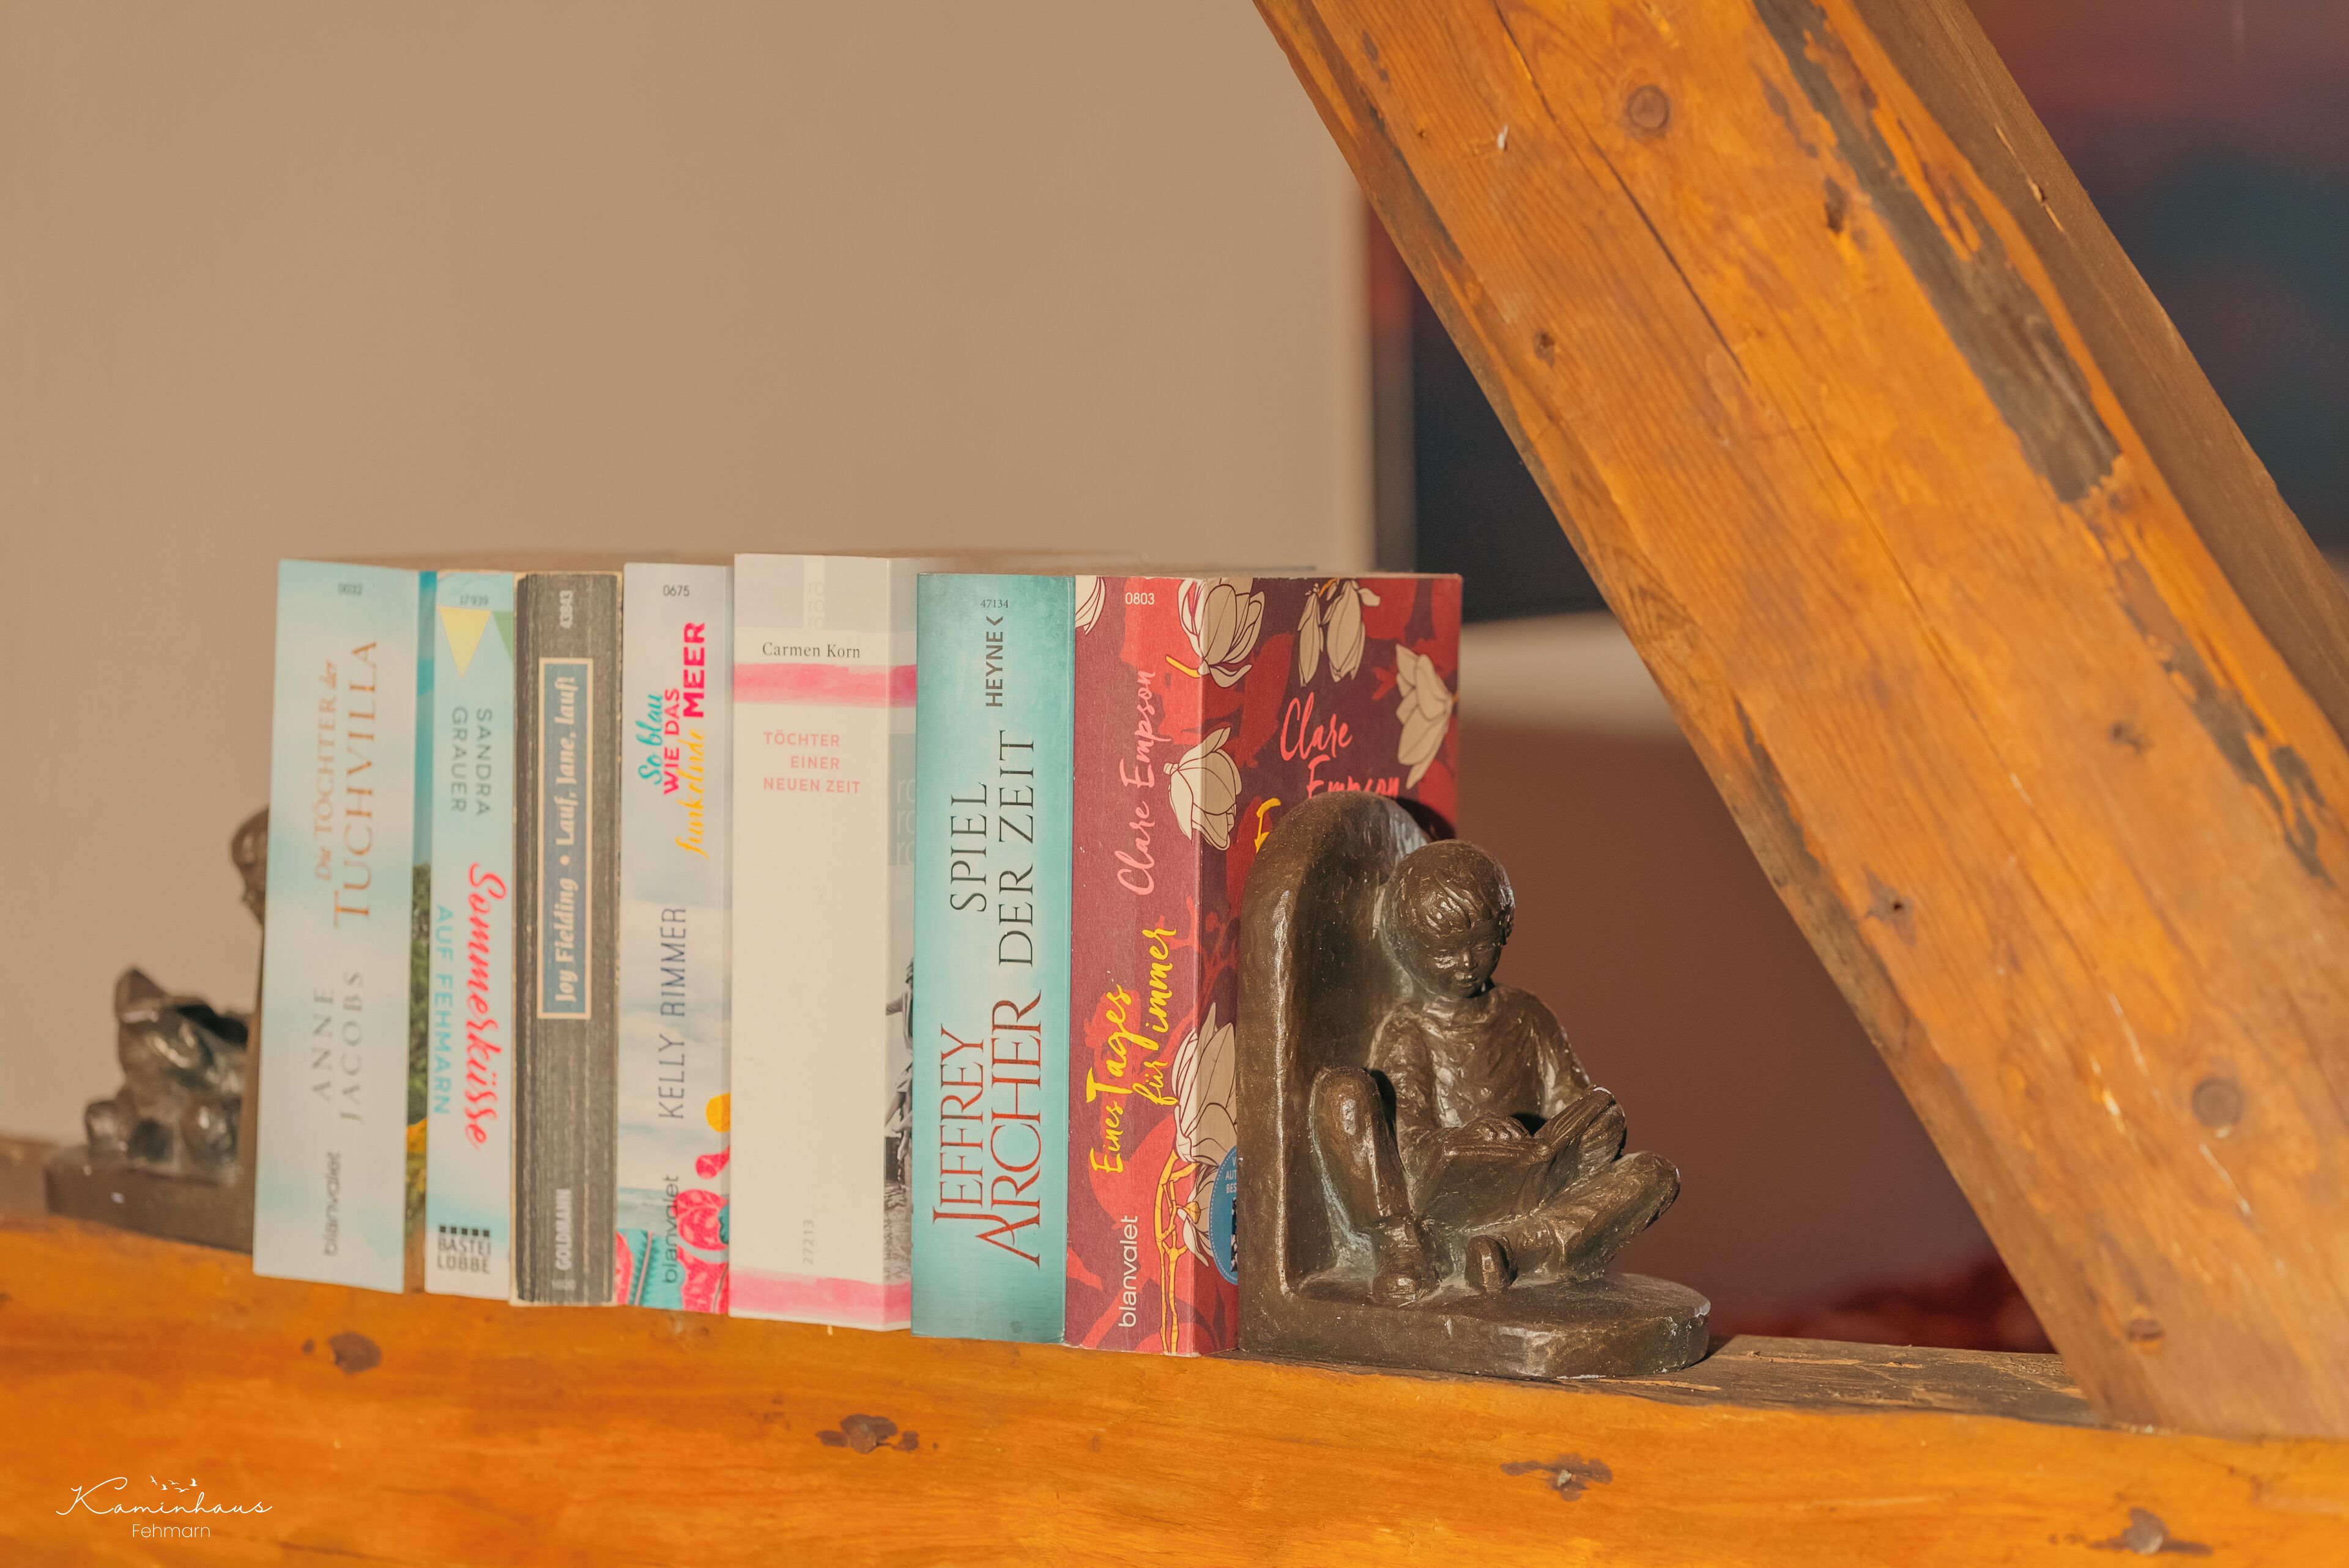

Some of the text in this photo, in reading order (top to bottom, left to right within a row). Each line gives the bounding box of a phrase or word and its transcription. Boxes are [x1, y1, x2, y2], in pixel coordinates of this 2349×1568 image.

[559, 589, 574, 630] 43843
[663, 585, 690, 597] 0675
[980, 599, 1009, 608] 47134
[1125, 592, 1155, 605] 0803
[683, 622, 706, 719] MEER
[762, 642, 861, 659] Carmen Korn
[985, 631, 1003, 707] HEYNE
[311, 658, 338, 882] Die TÖCHTER der
[451, 706, 468, 813] GRAUER
[475, 708, 492, 816] SANDRA
[636, 693, 664, 786] So blau
[663, 688, 680, 795] WIE DAS
[763, 730, 840, 747] TÖCHTER
[790, 756, 840, 769] EINER
[1280, 691, 1353, 761] Clare
[334, 642, 377, 928] TUCHVILLA
[675, 728, 710, 860] funkelnde
[763, 778, 861, 794] NEUEN ZEIT
[1115, 670, 1171, 895] Clare Empson
[553, 676, 579, 1002] Joy Fielding Lauf, Jane, lauf!
[950, 783, 987, 912] SPIEL
[998, 730, 1034, 968] DER ZEIT
[311, 988, 334, 1101] ANNE
[339, 971, 363, 1124] JACOBS
[432, 903, 453, 1115] AUF FEHMARN
[464, 862, 507, 1151] Sommerküsse
[658, 906, 686, 1120] KELLY RIMMER
[1133, 926, 1179, 1106] für immer
[975, 989, 1041, 1270] ARCHER
[1086, 983, 1159, 1174] Eines Tages
[933, 1023, 1015, 1246] JEFFREY
[323, 1151, 342, 1257] blanvalet
[438, 1237, 491, 1255] BASTEI
[555, 1188, 573, 1271] GOLDMANN
[662, 1175, 680, 1284] blanvalet
[803, 1219, 814, 1265] 27213
[1118, 1215, 1138, 1327] blanvalet
